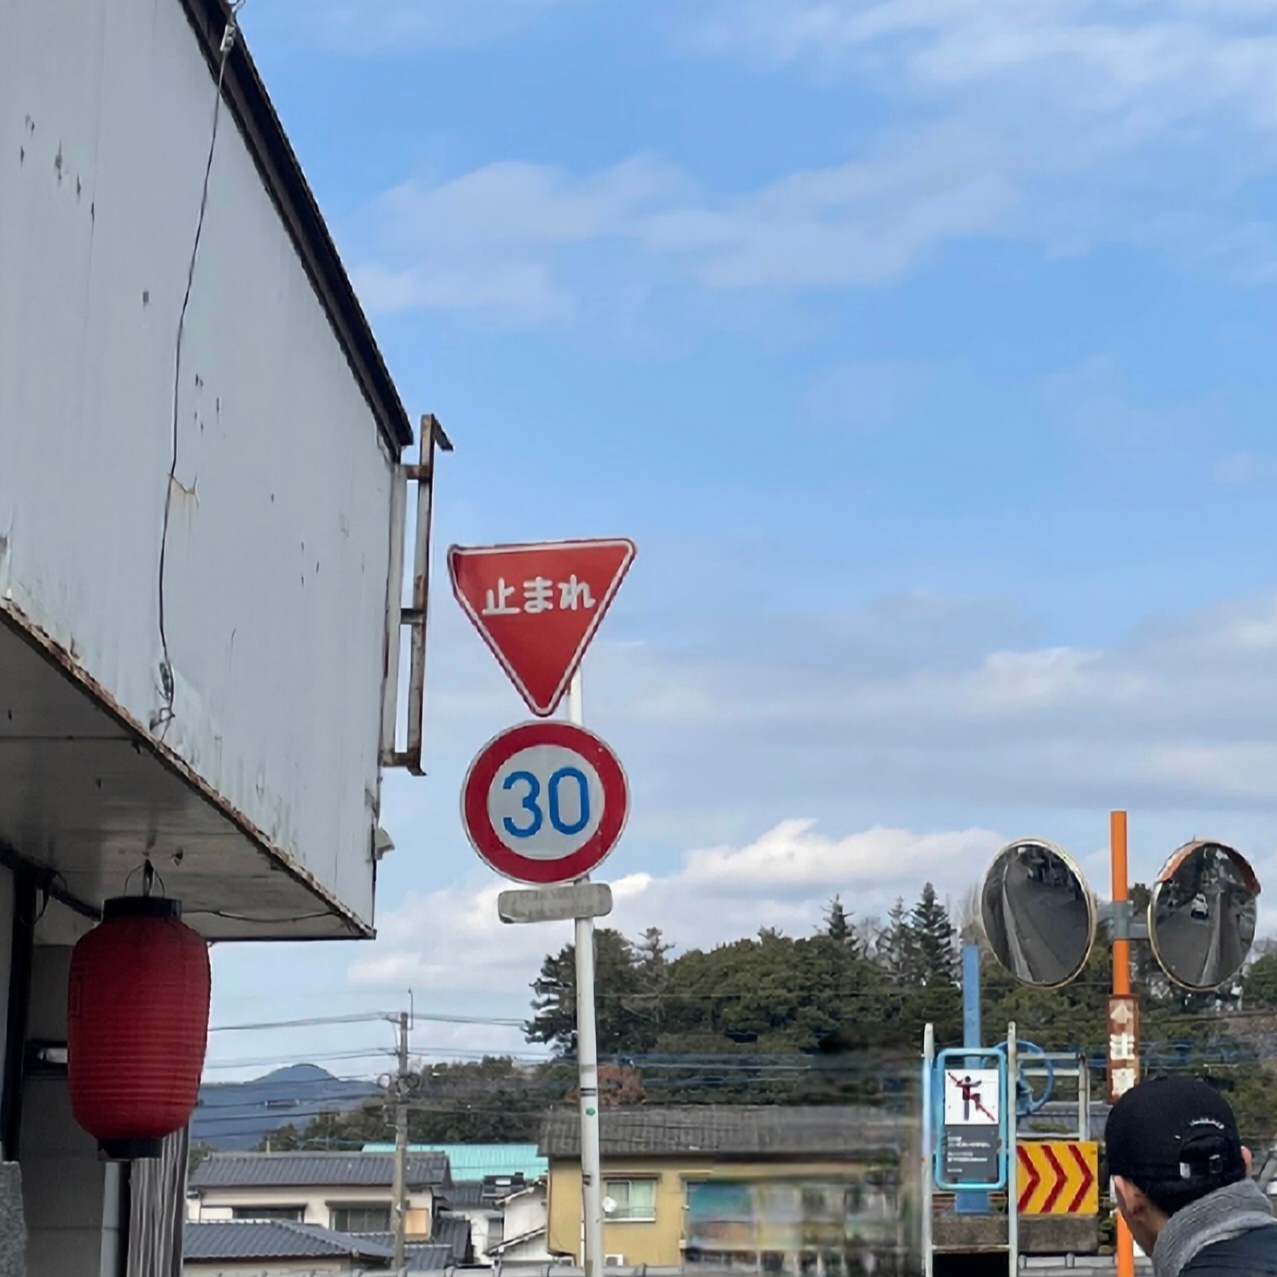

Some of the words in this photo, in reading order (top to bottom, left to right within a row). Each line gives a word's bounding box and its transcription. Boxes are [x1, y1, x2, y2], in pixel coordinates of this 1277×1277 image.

[481, 574, 596, 616] 止まれ
[501, 766, 591, 838] 30
